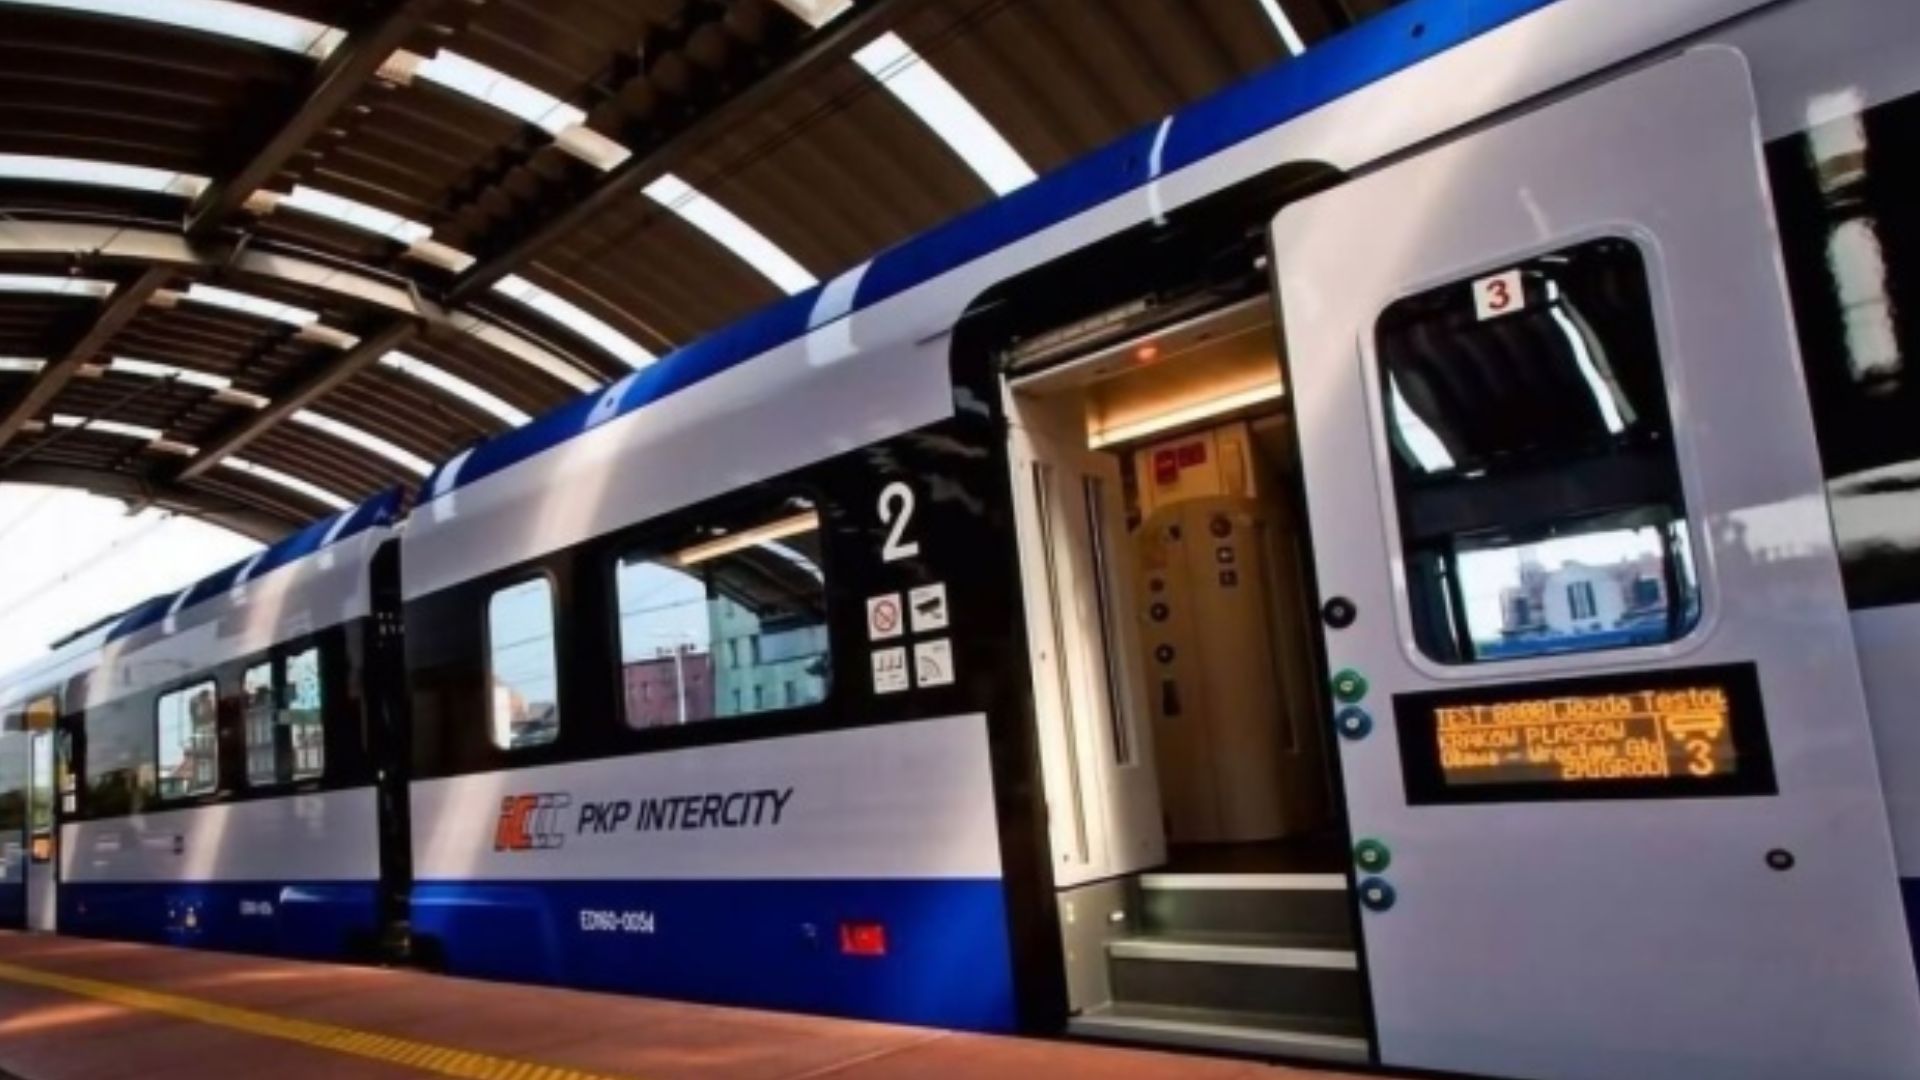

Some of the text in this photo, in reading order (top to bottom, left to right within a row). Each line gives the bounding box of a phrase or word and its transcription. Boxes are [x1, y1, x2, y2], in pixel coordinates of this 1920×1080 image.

[1486, 278, 1510, 310] 3
[877, 480, 920, 562] 2
[1685, 738, 1715, 776] 3
[577, 787, 795, 834] PKP INTERCITY
